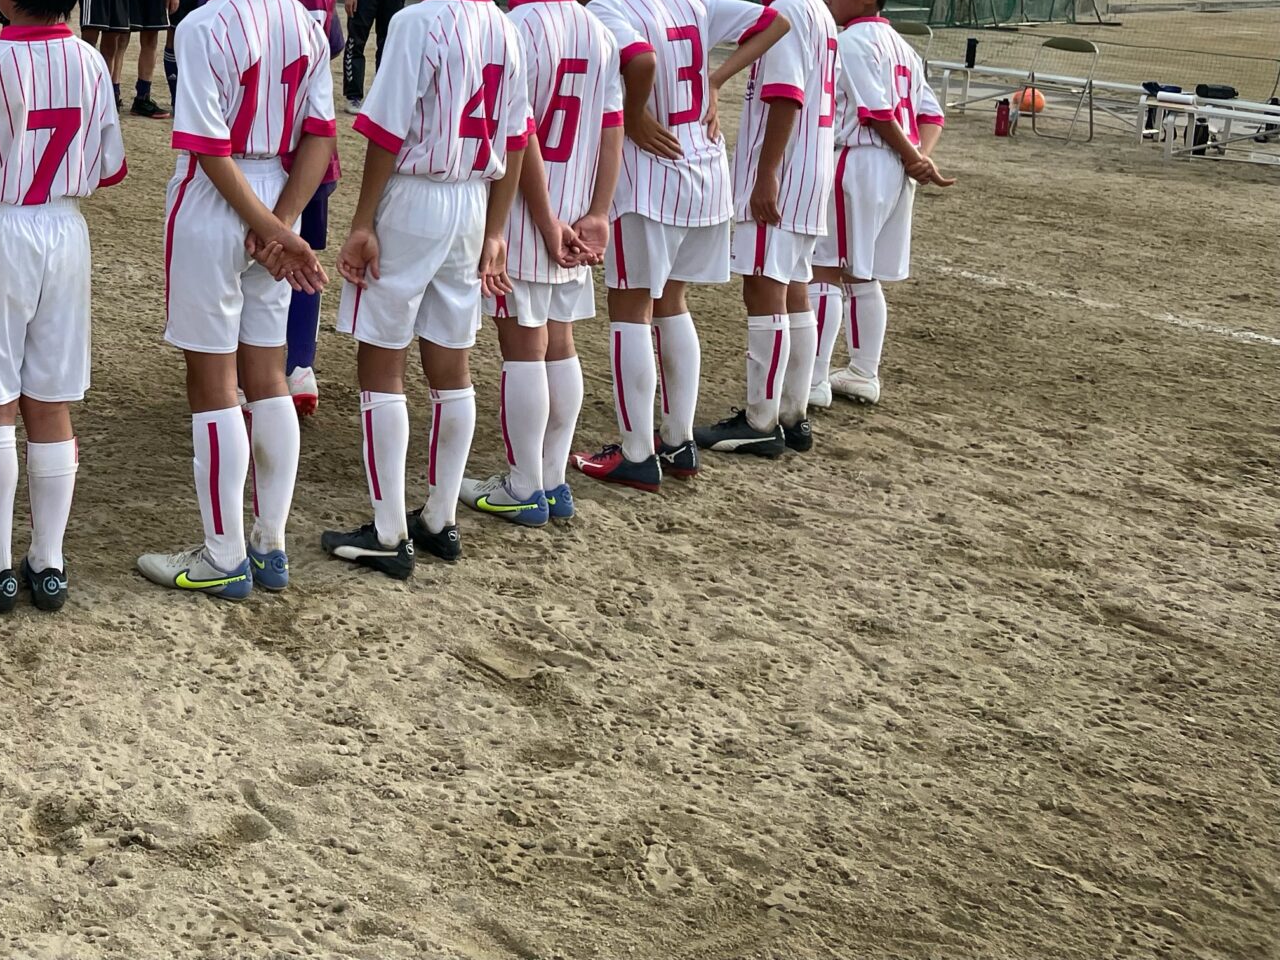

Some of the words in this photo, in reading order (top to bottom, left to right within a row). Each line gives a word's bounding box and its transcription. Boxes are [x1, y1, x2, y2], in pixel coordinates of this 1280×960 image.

[230, 54, 309, 155] 11
[459, 62, 506, 171] 4
[536, 58, 589, 163] 6
[666, 24, 704, 127] 3
[22, 106, 82, 206] 7
